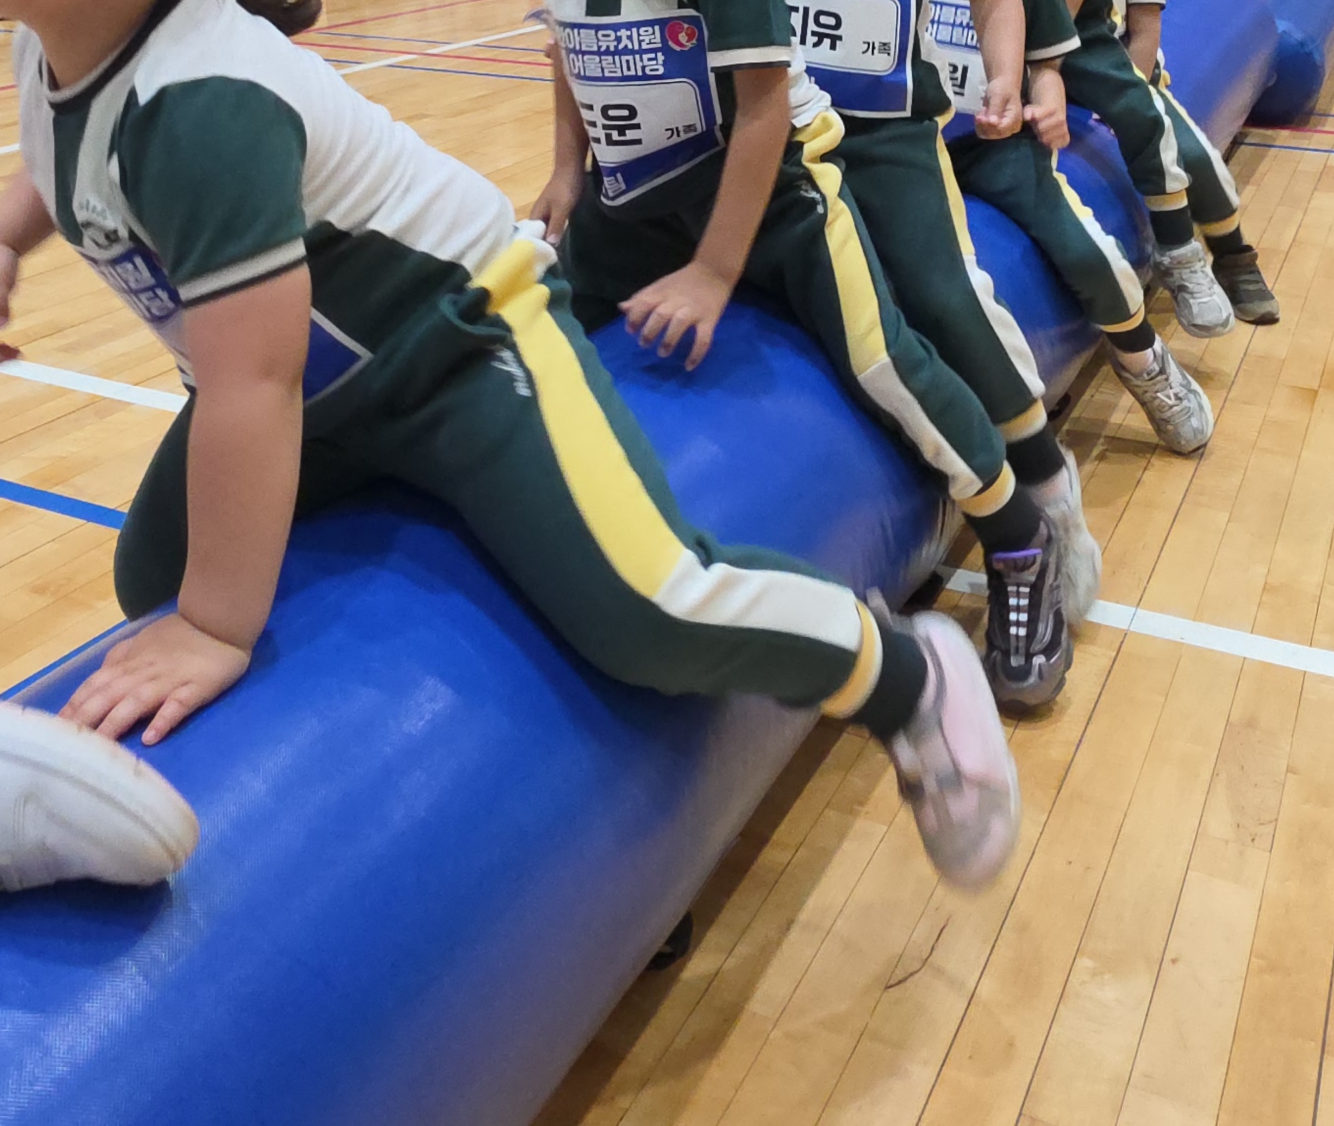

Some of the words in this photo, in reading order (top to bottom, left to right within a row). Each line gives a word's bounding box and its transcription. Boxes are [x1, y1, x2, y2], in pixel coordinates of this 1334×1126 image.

[862, 40, 892, 57] 가족
[569, 52, 665, 77] 어울림마당
[664, 123, 698, 141] 가족
